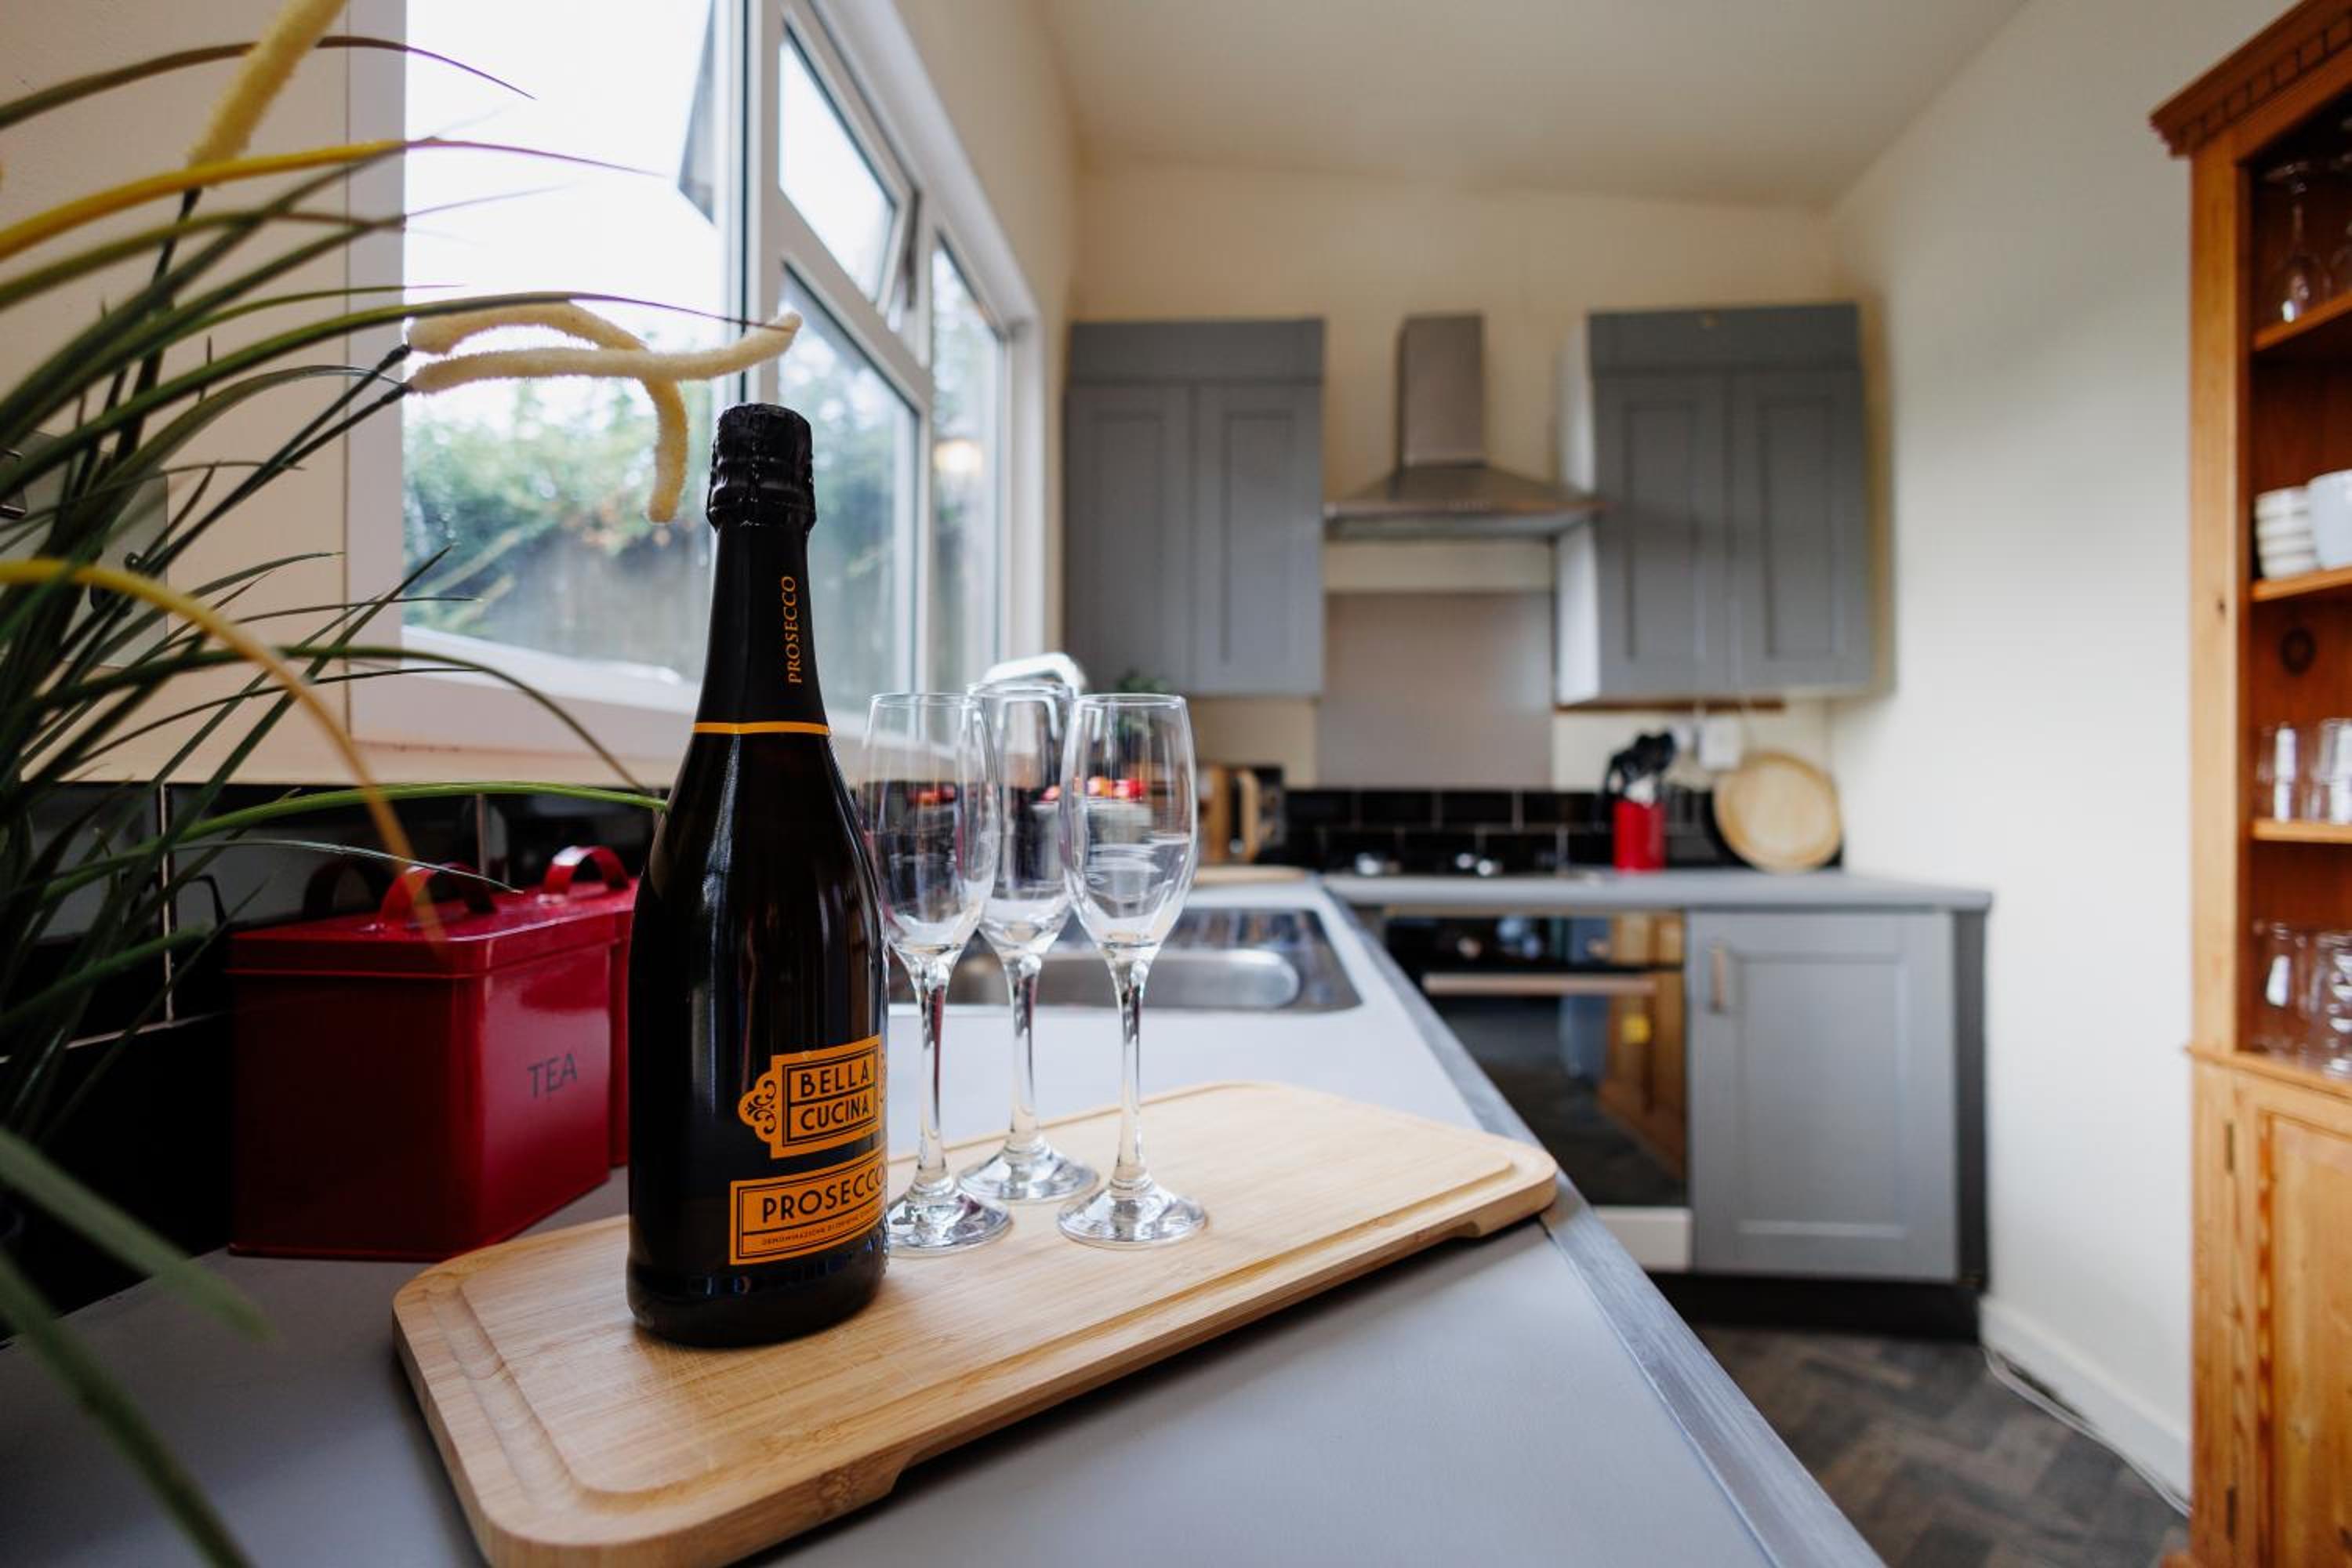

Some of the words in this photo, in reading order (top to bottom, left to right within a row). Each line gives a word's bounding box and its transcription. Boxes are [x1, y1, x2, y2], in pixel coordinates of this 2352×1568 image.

[780, 575, 802, 684] PROSECCO
[526, 1053, 578, 1098] TEA
[800, 1060, 869, 1097] BELLA
[800, 1094, 869, 1131] CUCINA
[763, 1165, 885, 1223] PROSECCO
